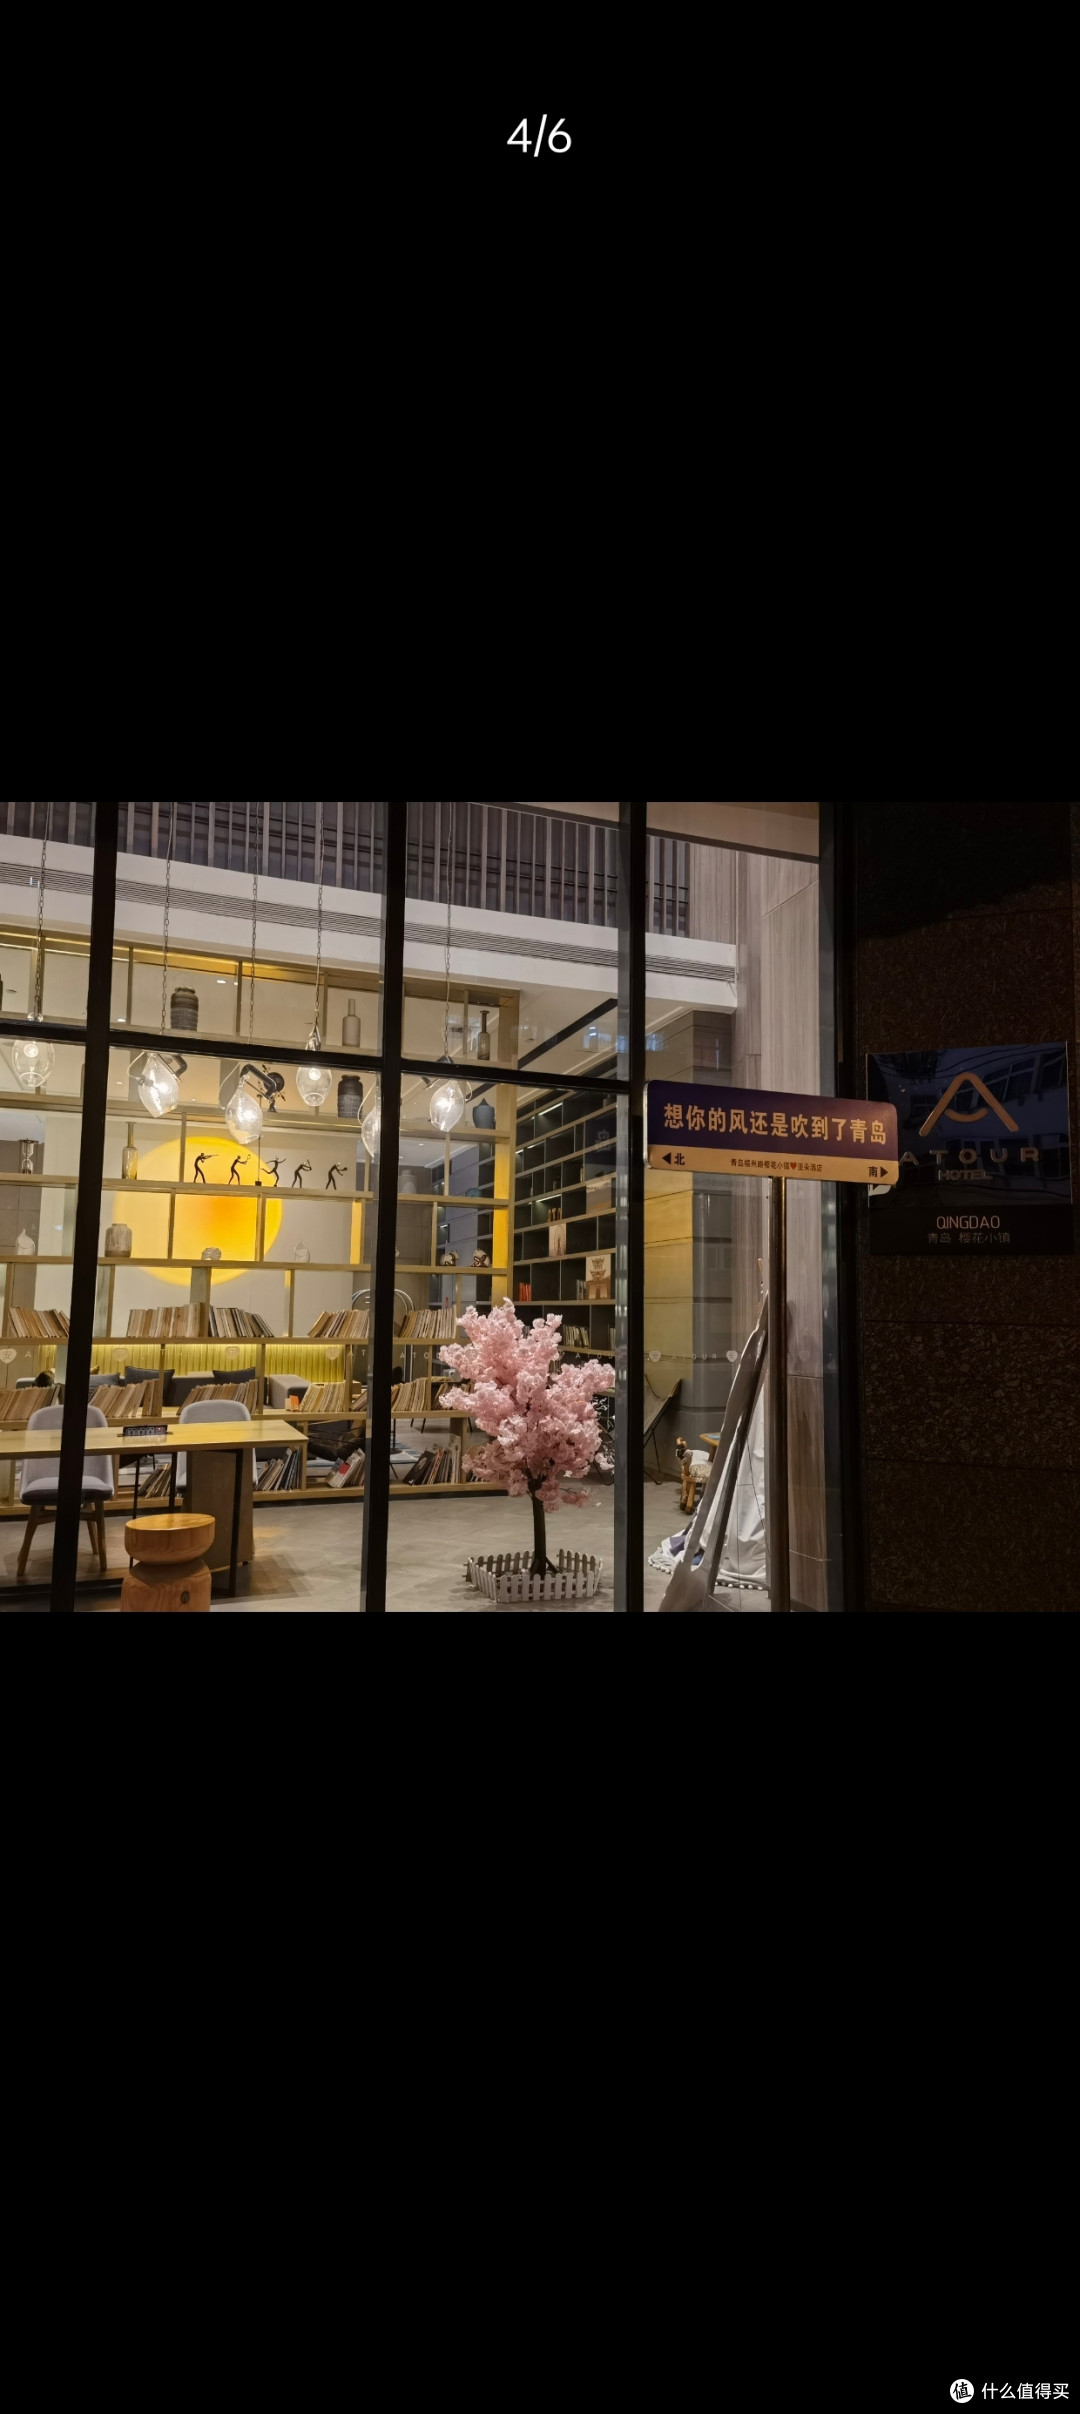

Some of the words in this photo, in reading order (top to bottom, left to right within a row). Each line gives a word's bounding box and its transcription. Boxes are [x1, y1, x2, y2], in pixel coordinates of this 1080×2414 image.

[664, 1102, 887, 1145] 想你的风还是吹到了青岛
[673, 1152, 686, 1166] 北
[898, 1146, 1040, 1167] ATOUR
[868, 1166, 878, 1178] 南
[938, 1169, 993, 1181] HOTEL
[936, 1215, 1001, 1230] QINGDAO
[928, 1231, 952, 1245] 青岛
[958, 1231, 1011, 1245] 樱花小镇
